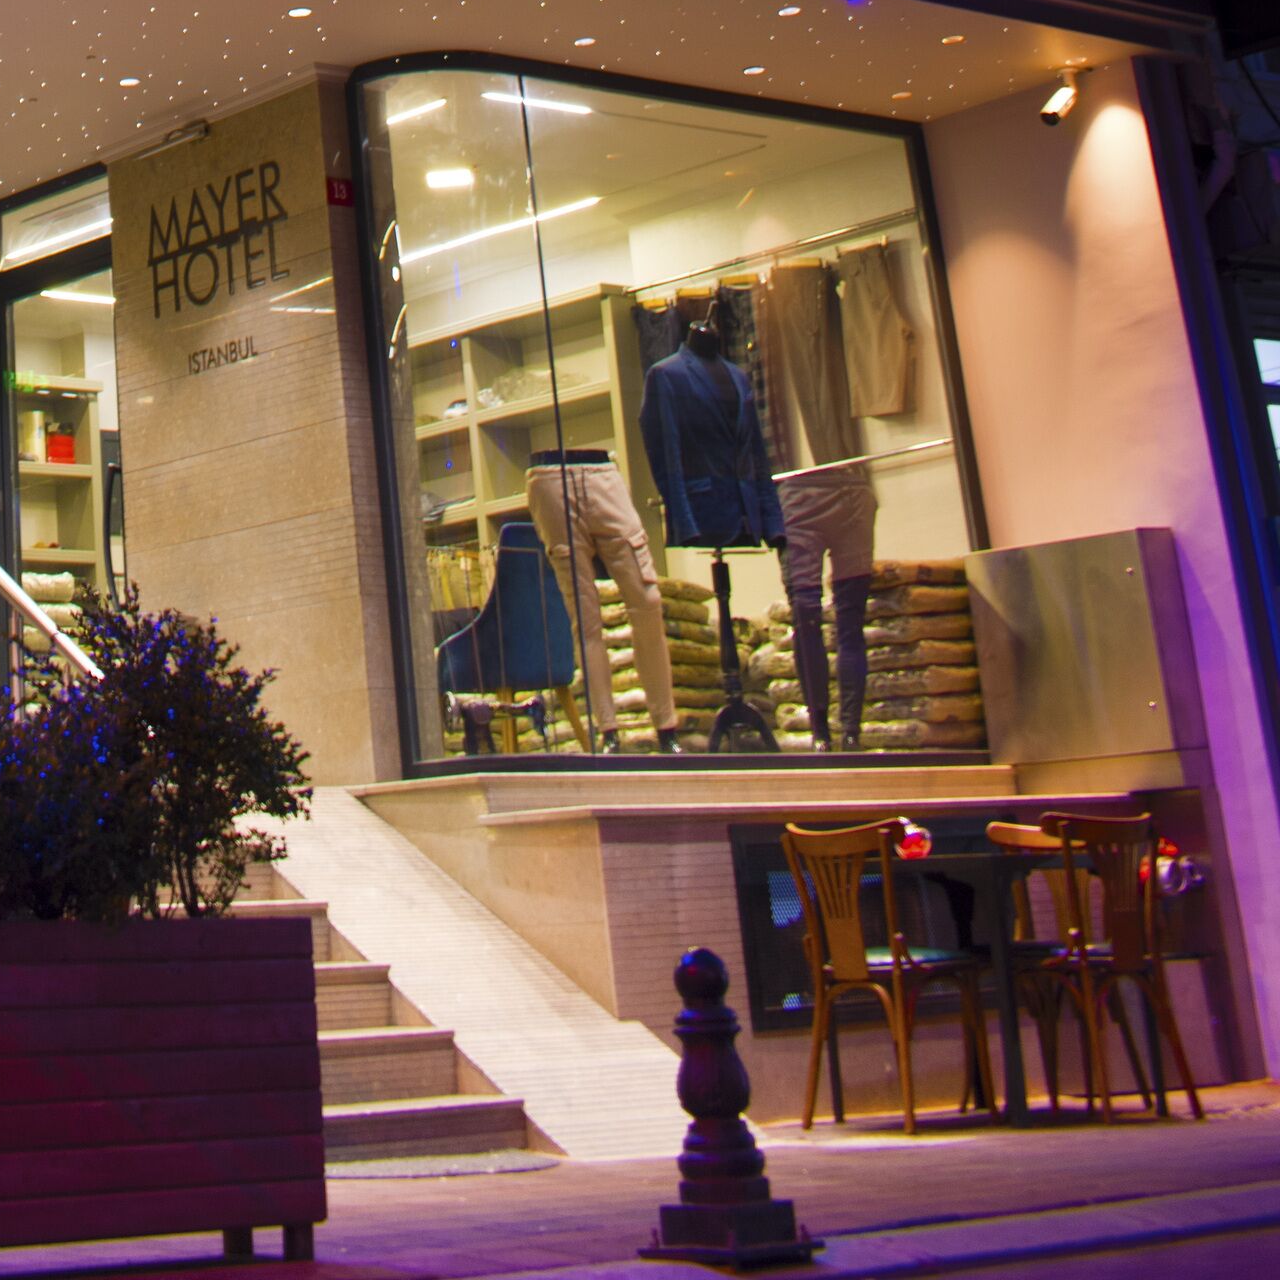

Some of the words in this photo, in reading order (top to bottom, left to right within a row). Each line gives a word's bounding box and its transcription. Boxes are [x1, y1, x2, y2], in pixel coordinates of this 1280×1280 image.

[148, 160, 288, 267] MAYER
[333, 181, 347, 200] 13
[151, 216, 290, 319] HOTEL
[188, 336, 258, 374] ISTANBUL
